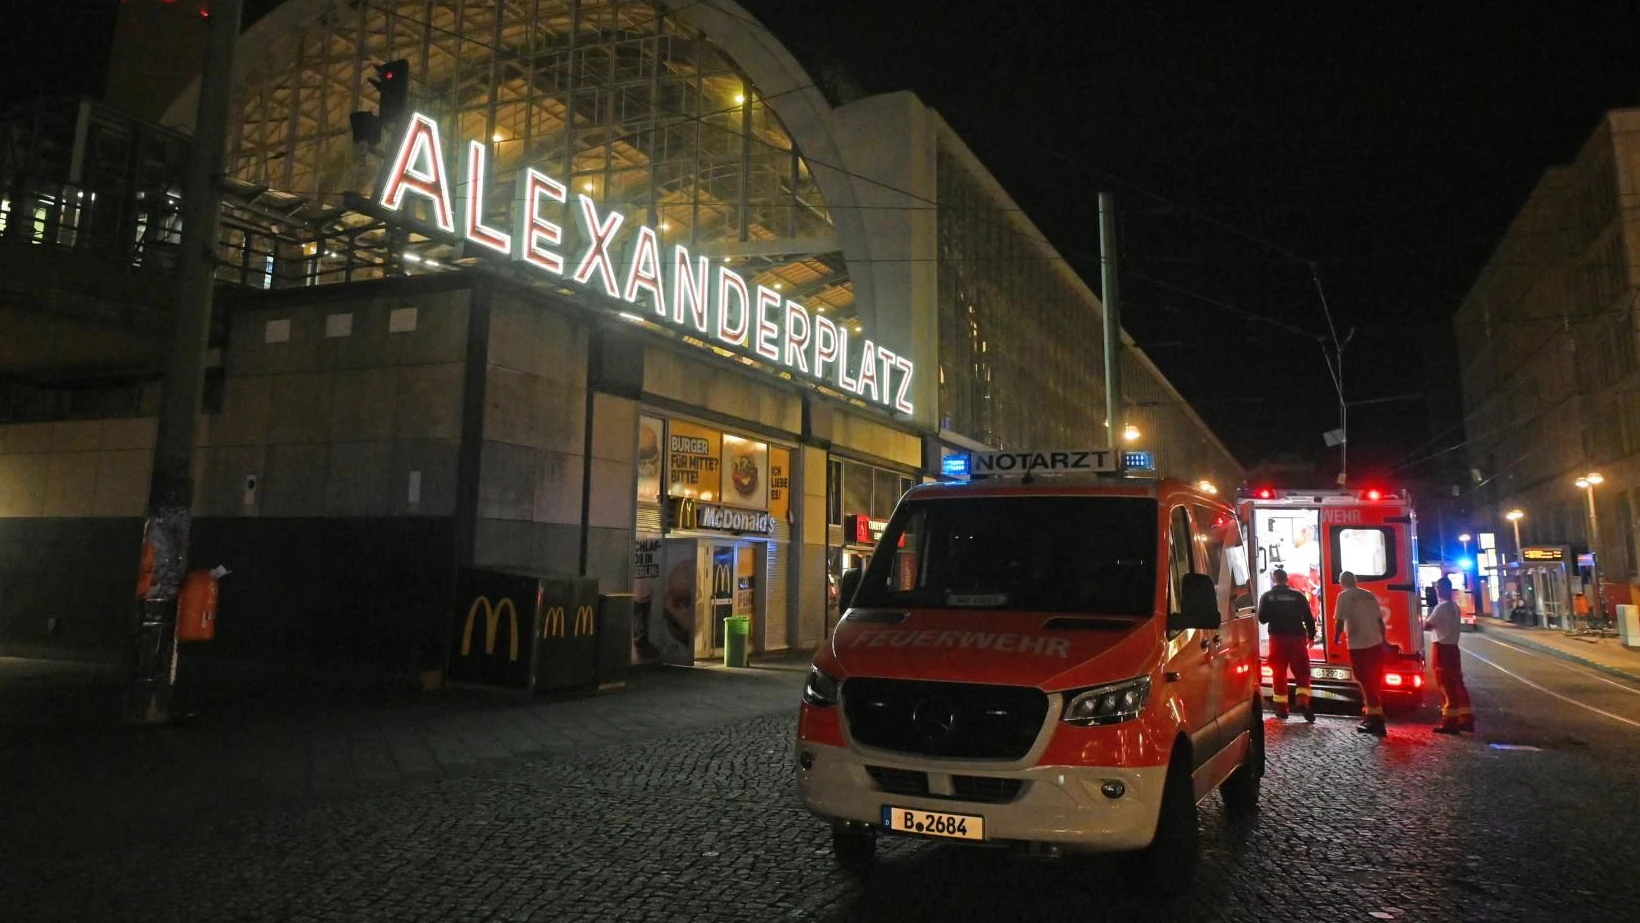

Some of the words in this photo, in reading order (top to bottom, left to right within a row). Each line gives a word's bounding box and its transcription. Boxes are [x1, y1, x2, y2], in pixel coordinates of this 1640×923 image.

[380, 112, 915, 415] ALEXANDERPLATZ
[671, 436, 708, 454] BURGER
[671, 453, 687, 470] FÜR
[690, 455, 718, 471] MITTE?
[976, 451, 1110, 470] NOTARZT
[671, 469, 699, 483] BITTE!
[771, 466, 781, 476] ICH
[771, 477, 788, 488] LIEBE
[771, 489, 781, 500] ES!
[703, 506, 776, 533] McDonald's
[851, 630, 1072, 659] FEUERWEHR
